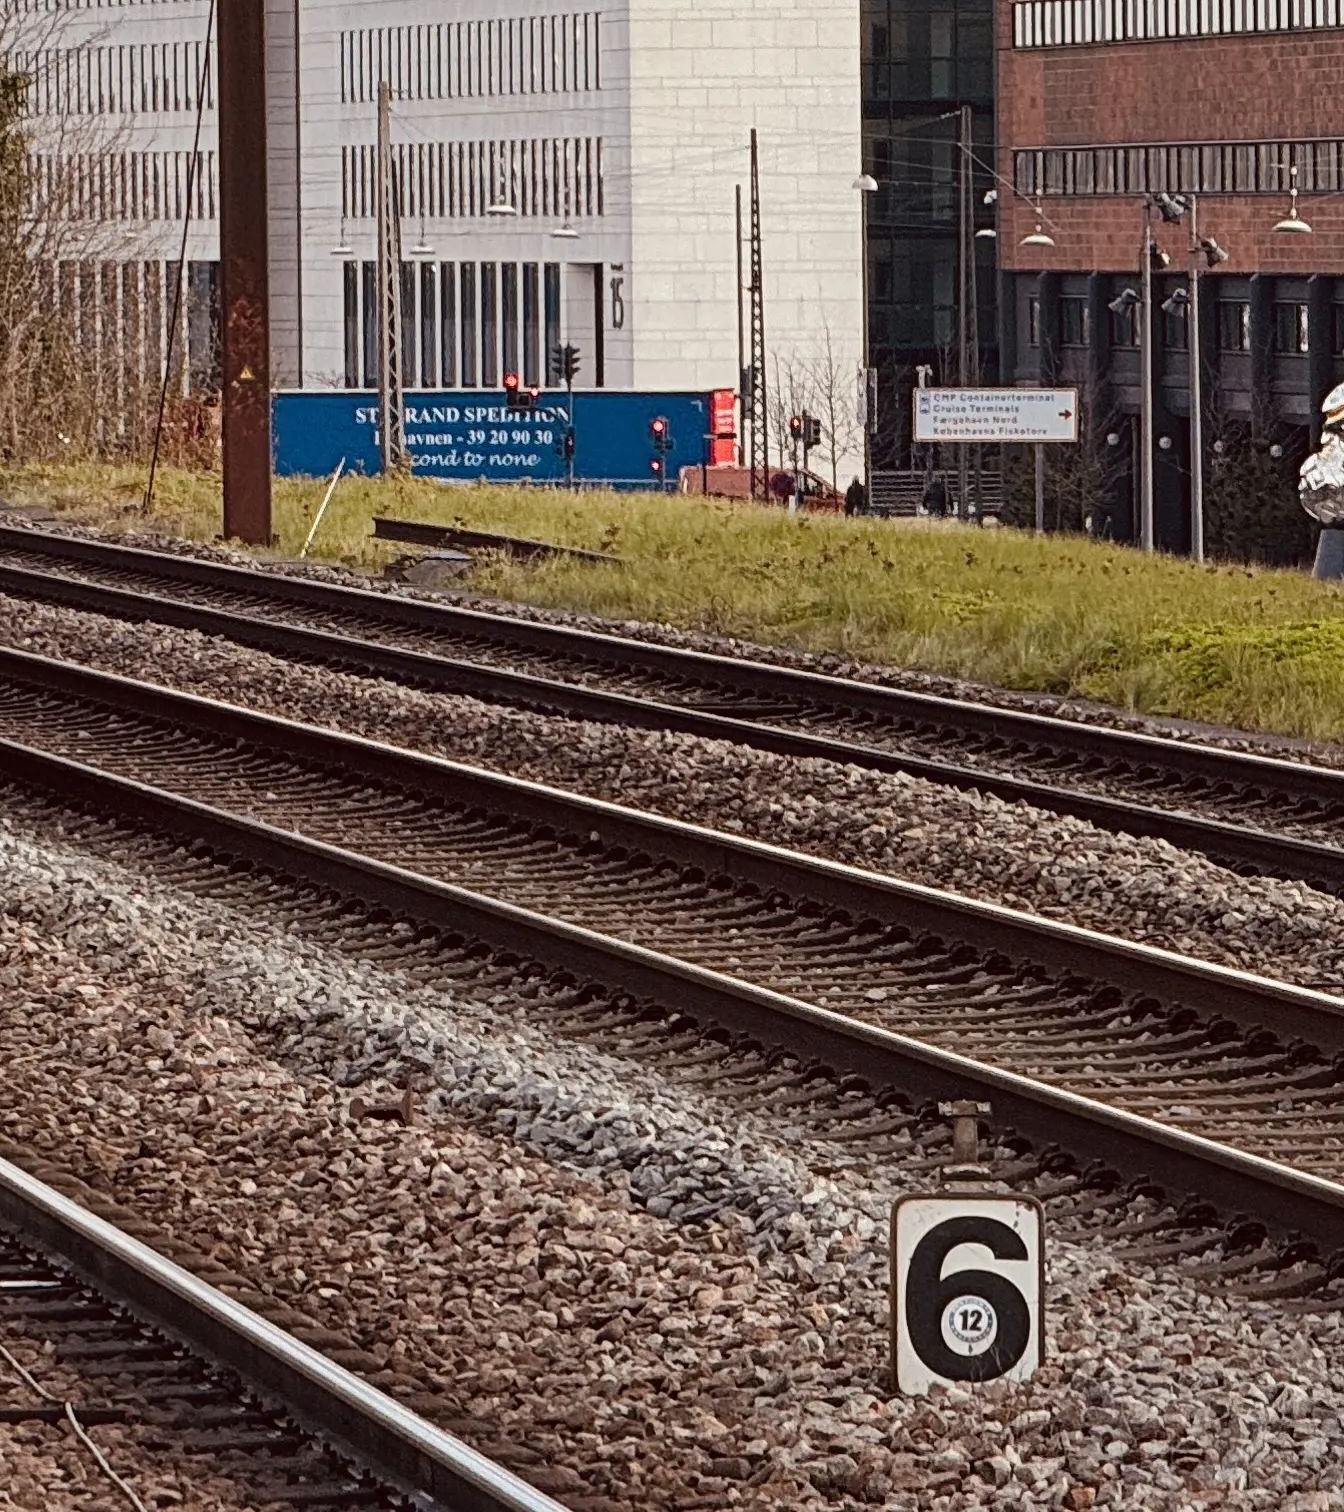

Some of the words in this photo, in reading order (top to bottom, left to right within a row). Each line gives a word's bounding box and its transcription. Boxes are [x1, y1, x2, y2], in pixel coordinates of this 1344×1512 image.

[355, 407, 460, 424] STRAND
[466, 430, 486, 446] 39
[489, 430, 509, 445] 20
[512, 430, 531, 445] 90
[534, 430, 553, 445] 30
[464, 451, 486, 467] to
[489, 453, 541, 467] none
[905, 1216, 1031, 1383] 6
[959, 1309, 983, 1332] 12
